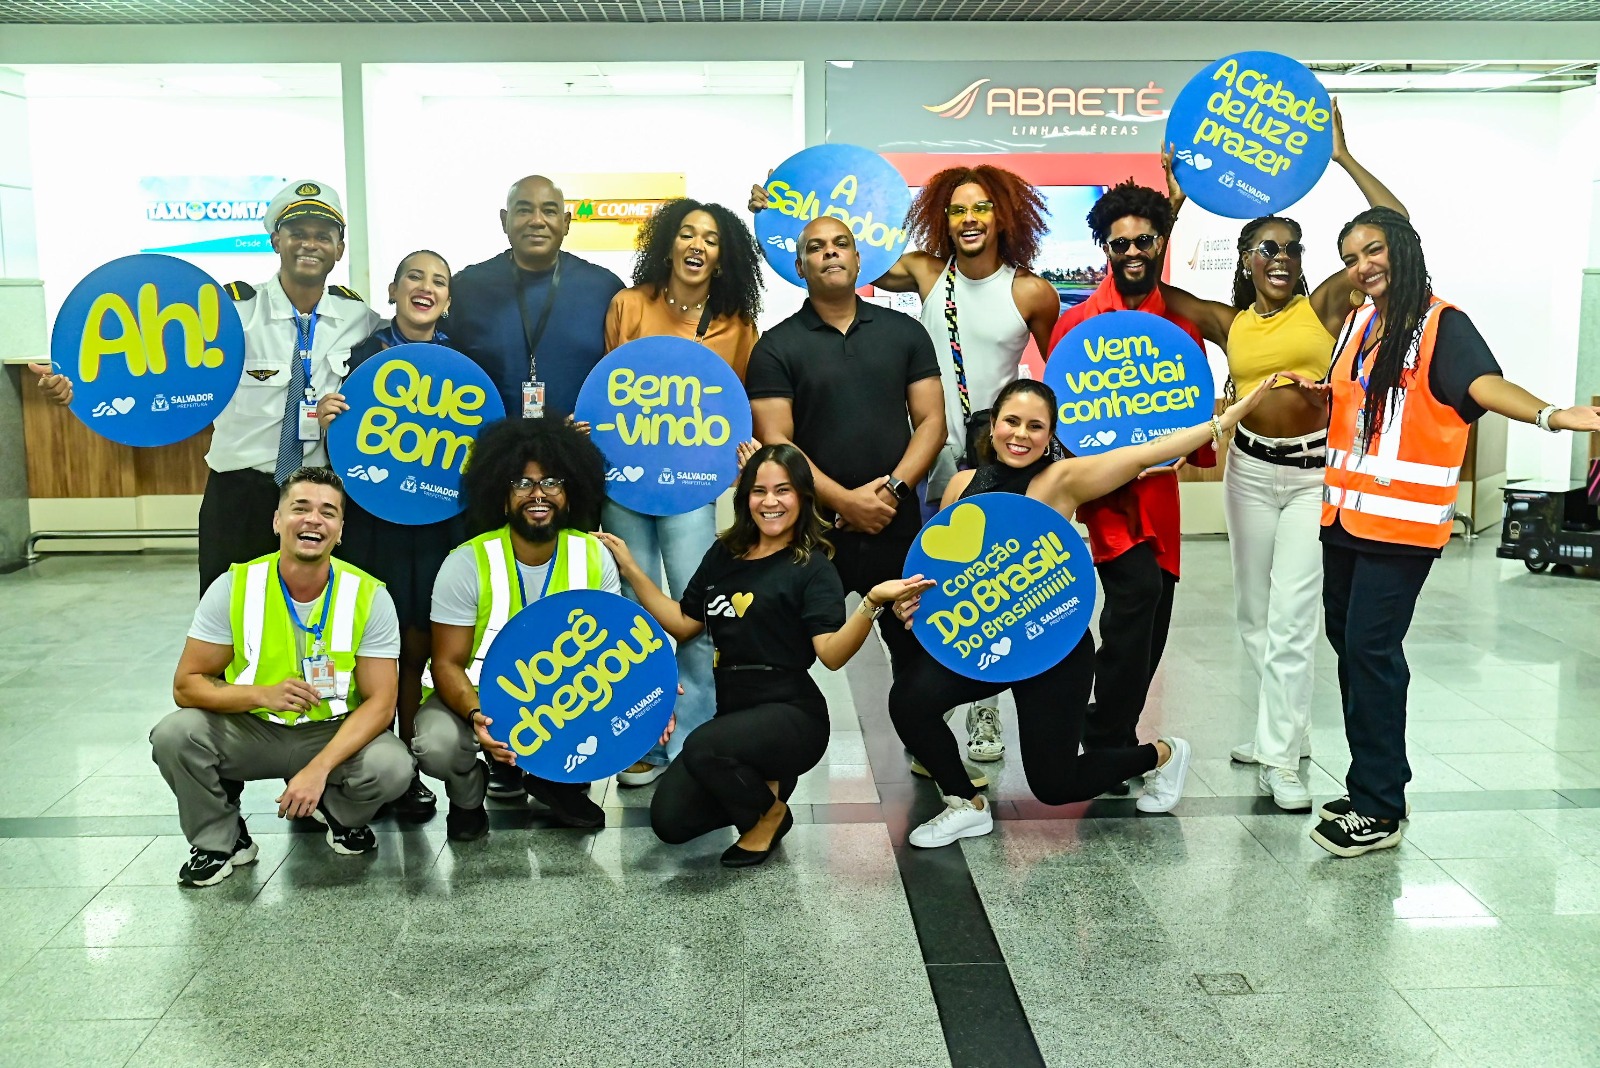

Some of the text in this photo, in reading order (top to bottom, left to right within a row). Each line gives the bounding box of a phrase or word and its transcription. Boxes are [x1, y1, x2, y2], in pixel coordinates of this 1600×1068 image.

[1212, 59, 1238, 87] A
[987, 81, 1165, 116] ABAETÉ
[1012, 123, 1139, 137] LINHAS AÉREAS
[1206, 89, 1309, 155] de luz e
[1193, 117, 1292, 177] prazer
[830, 174, 858, 206] A
[1235, 179, 1271, 204] SALVADOR
[147, 201, 187, 221] TAXI
[598, 202, 664, 217] COOMET
[235, 238, 262, 248] Desde
[78, 282, 224, 383] Ah!
[1083, 335, 1160, 363] Vem,
[607, 367, 723, 408] Bem-
[1065, 354, 1185, 395] você vai
[170, 393, 213, 404] SALVADOR
[177, 401, 208, 409] PREFEITURA
[373, 359, 486, 426] Que
[1058, 385, 1200, 425] conhecer
[356, 406, 476, 475] Bom
[595, 405, 731, 447] -vindo
[419, 481, 459, 499] SALVADOR
[676, 471, 718, 482] SALVADOR
[971, 531, 1071, 613] Brasil!
[1040, 596, 1081, 625] SALVADOR
[1049, 606, 1079, 627] PREFEITURA
[496, 608, 609, 703] Você
[509, 614, 663, 756] chegou!
[625, 686, 664, 719] SALVADOR
[634, 697, 663, 720] PREFEITURA
